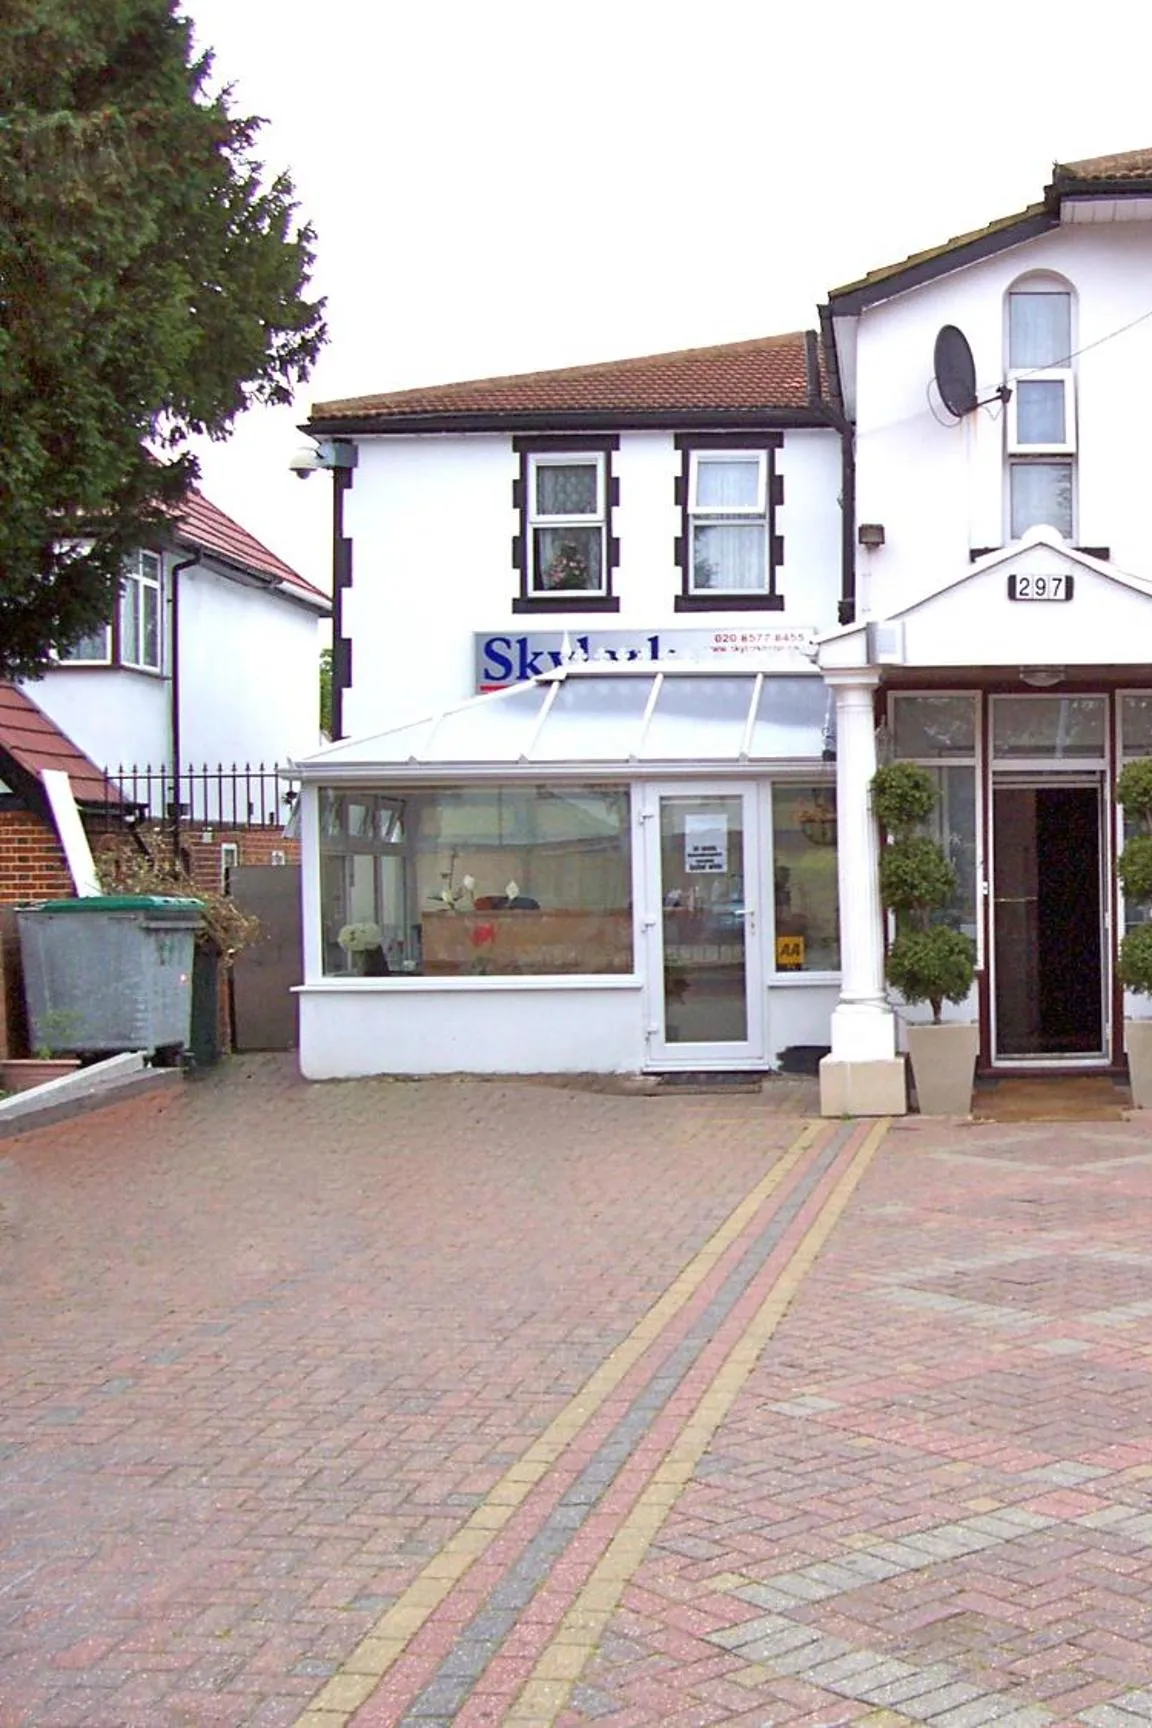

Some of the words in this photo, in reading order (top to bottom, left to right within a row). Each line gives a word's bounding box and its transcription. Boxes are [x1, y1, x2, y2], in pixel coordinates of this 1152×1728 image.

[1018, 577, 1063, 597] 297
[714, 633, 737, 643] 020
[780, 943, 800, 957] AA
